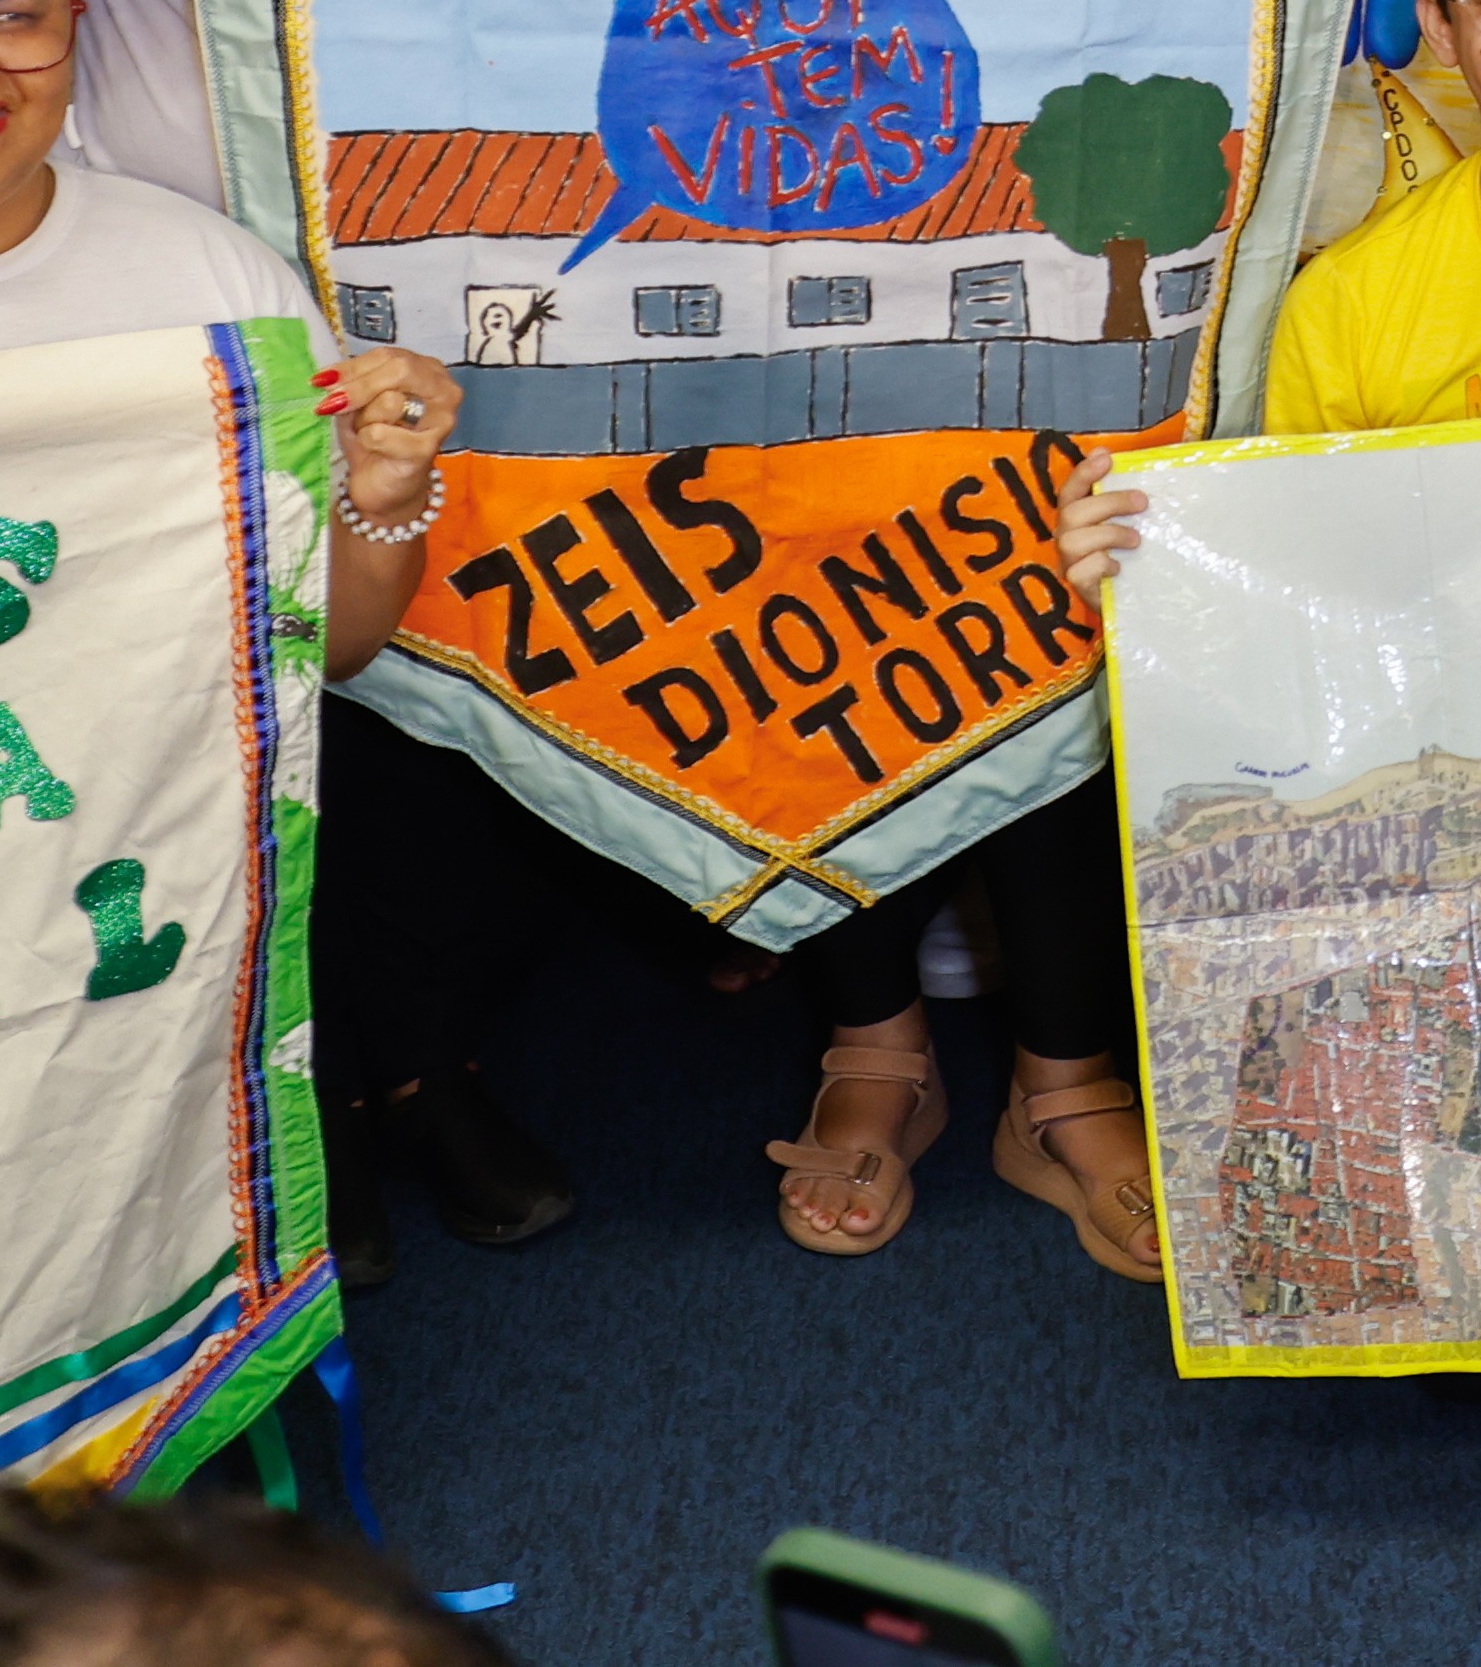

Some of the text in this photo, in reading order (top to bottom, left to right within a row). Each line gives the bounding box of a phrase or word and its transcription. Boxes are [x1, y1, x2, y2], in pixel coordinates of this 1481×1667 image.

[649, 54, 959, 209] VIDAS!
[727, 29, 922, 122] TEM
[449, 445, 764, 696] ZEIS
